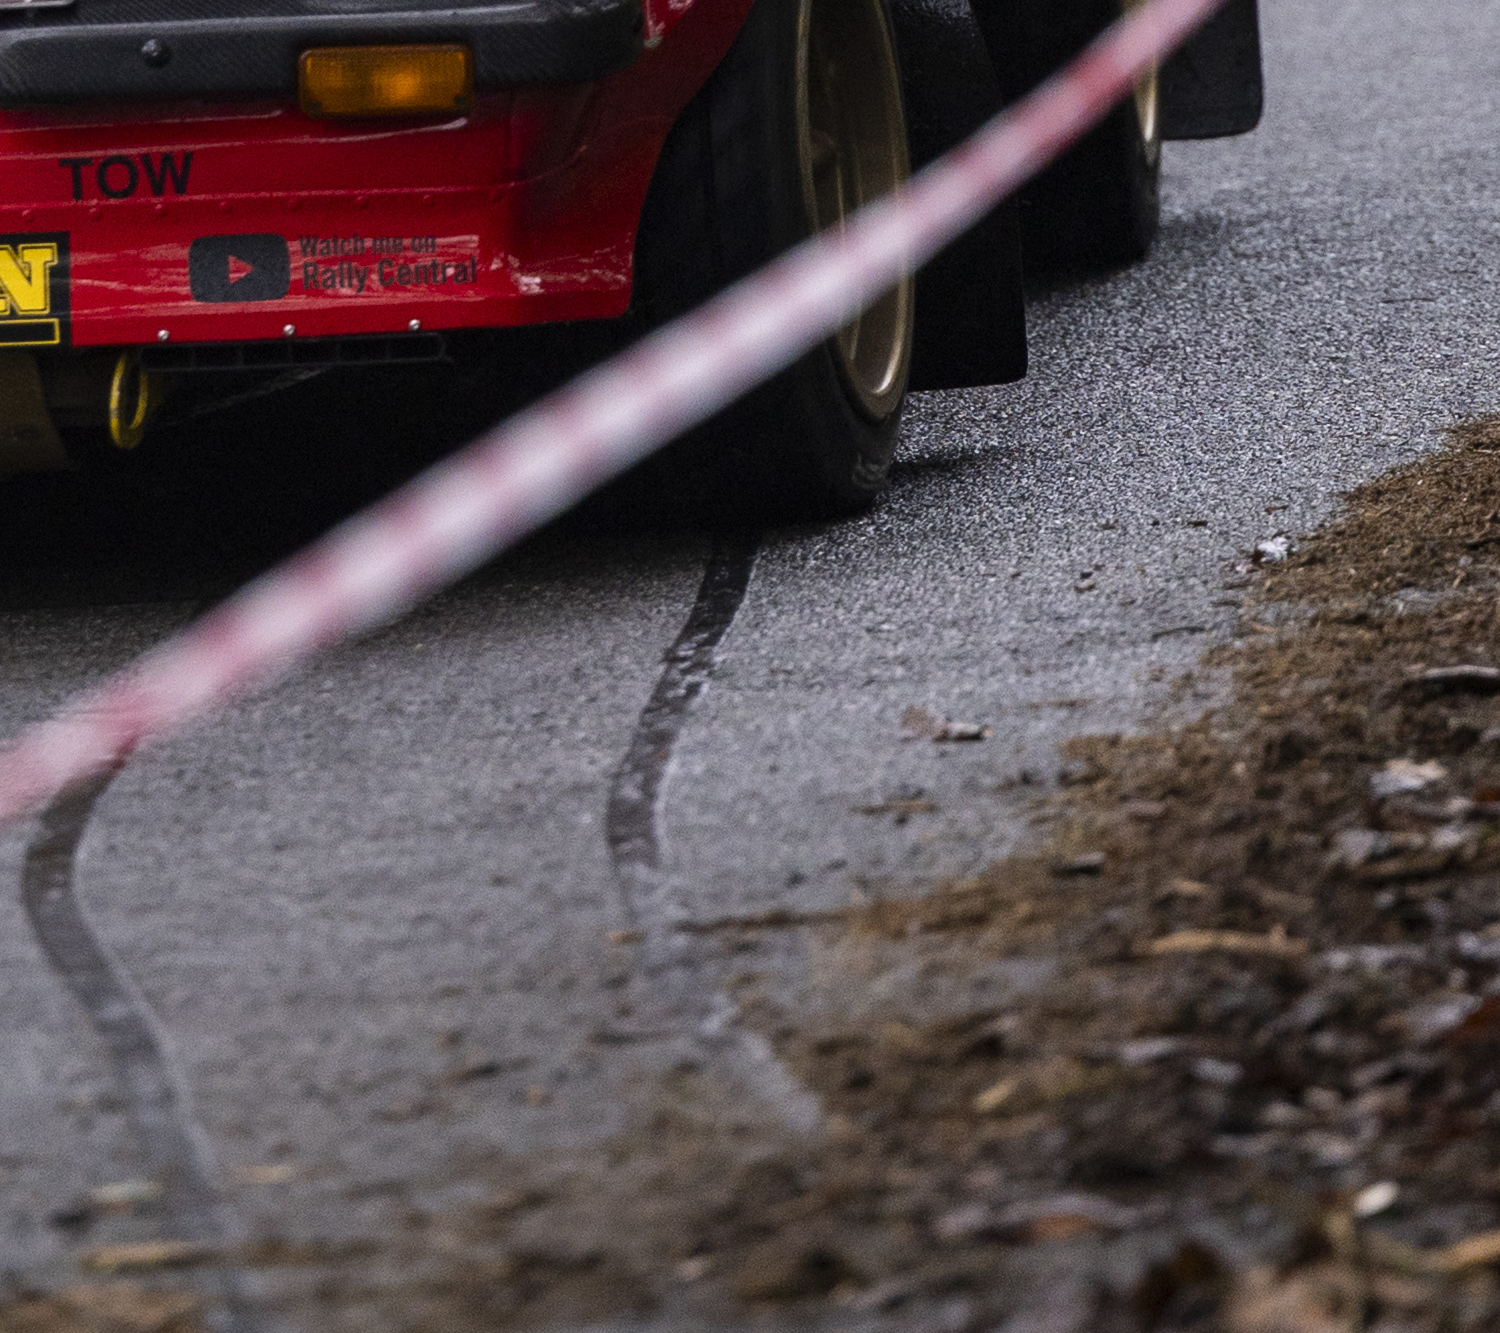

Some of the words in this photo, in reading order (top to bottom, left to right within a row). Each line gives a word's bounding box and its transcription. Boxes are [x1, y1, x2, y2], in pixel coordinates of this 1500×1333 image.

[59, 152, 194, 201] TOW
[299, 234, 365, 256] Watch
[372, 237, 403, 254] me
[410, 235, 436, 253] on
[302, 260, 368, 293] Rally
[377, 256, 477, 286] Central
